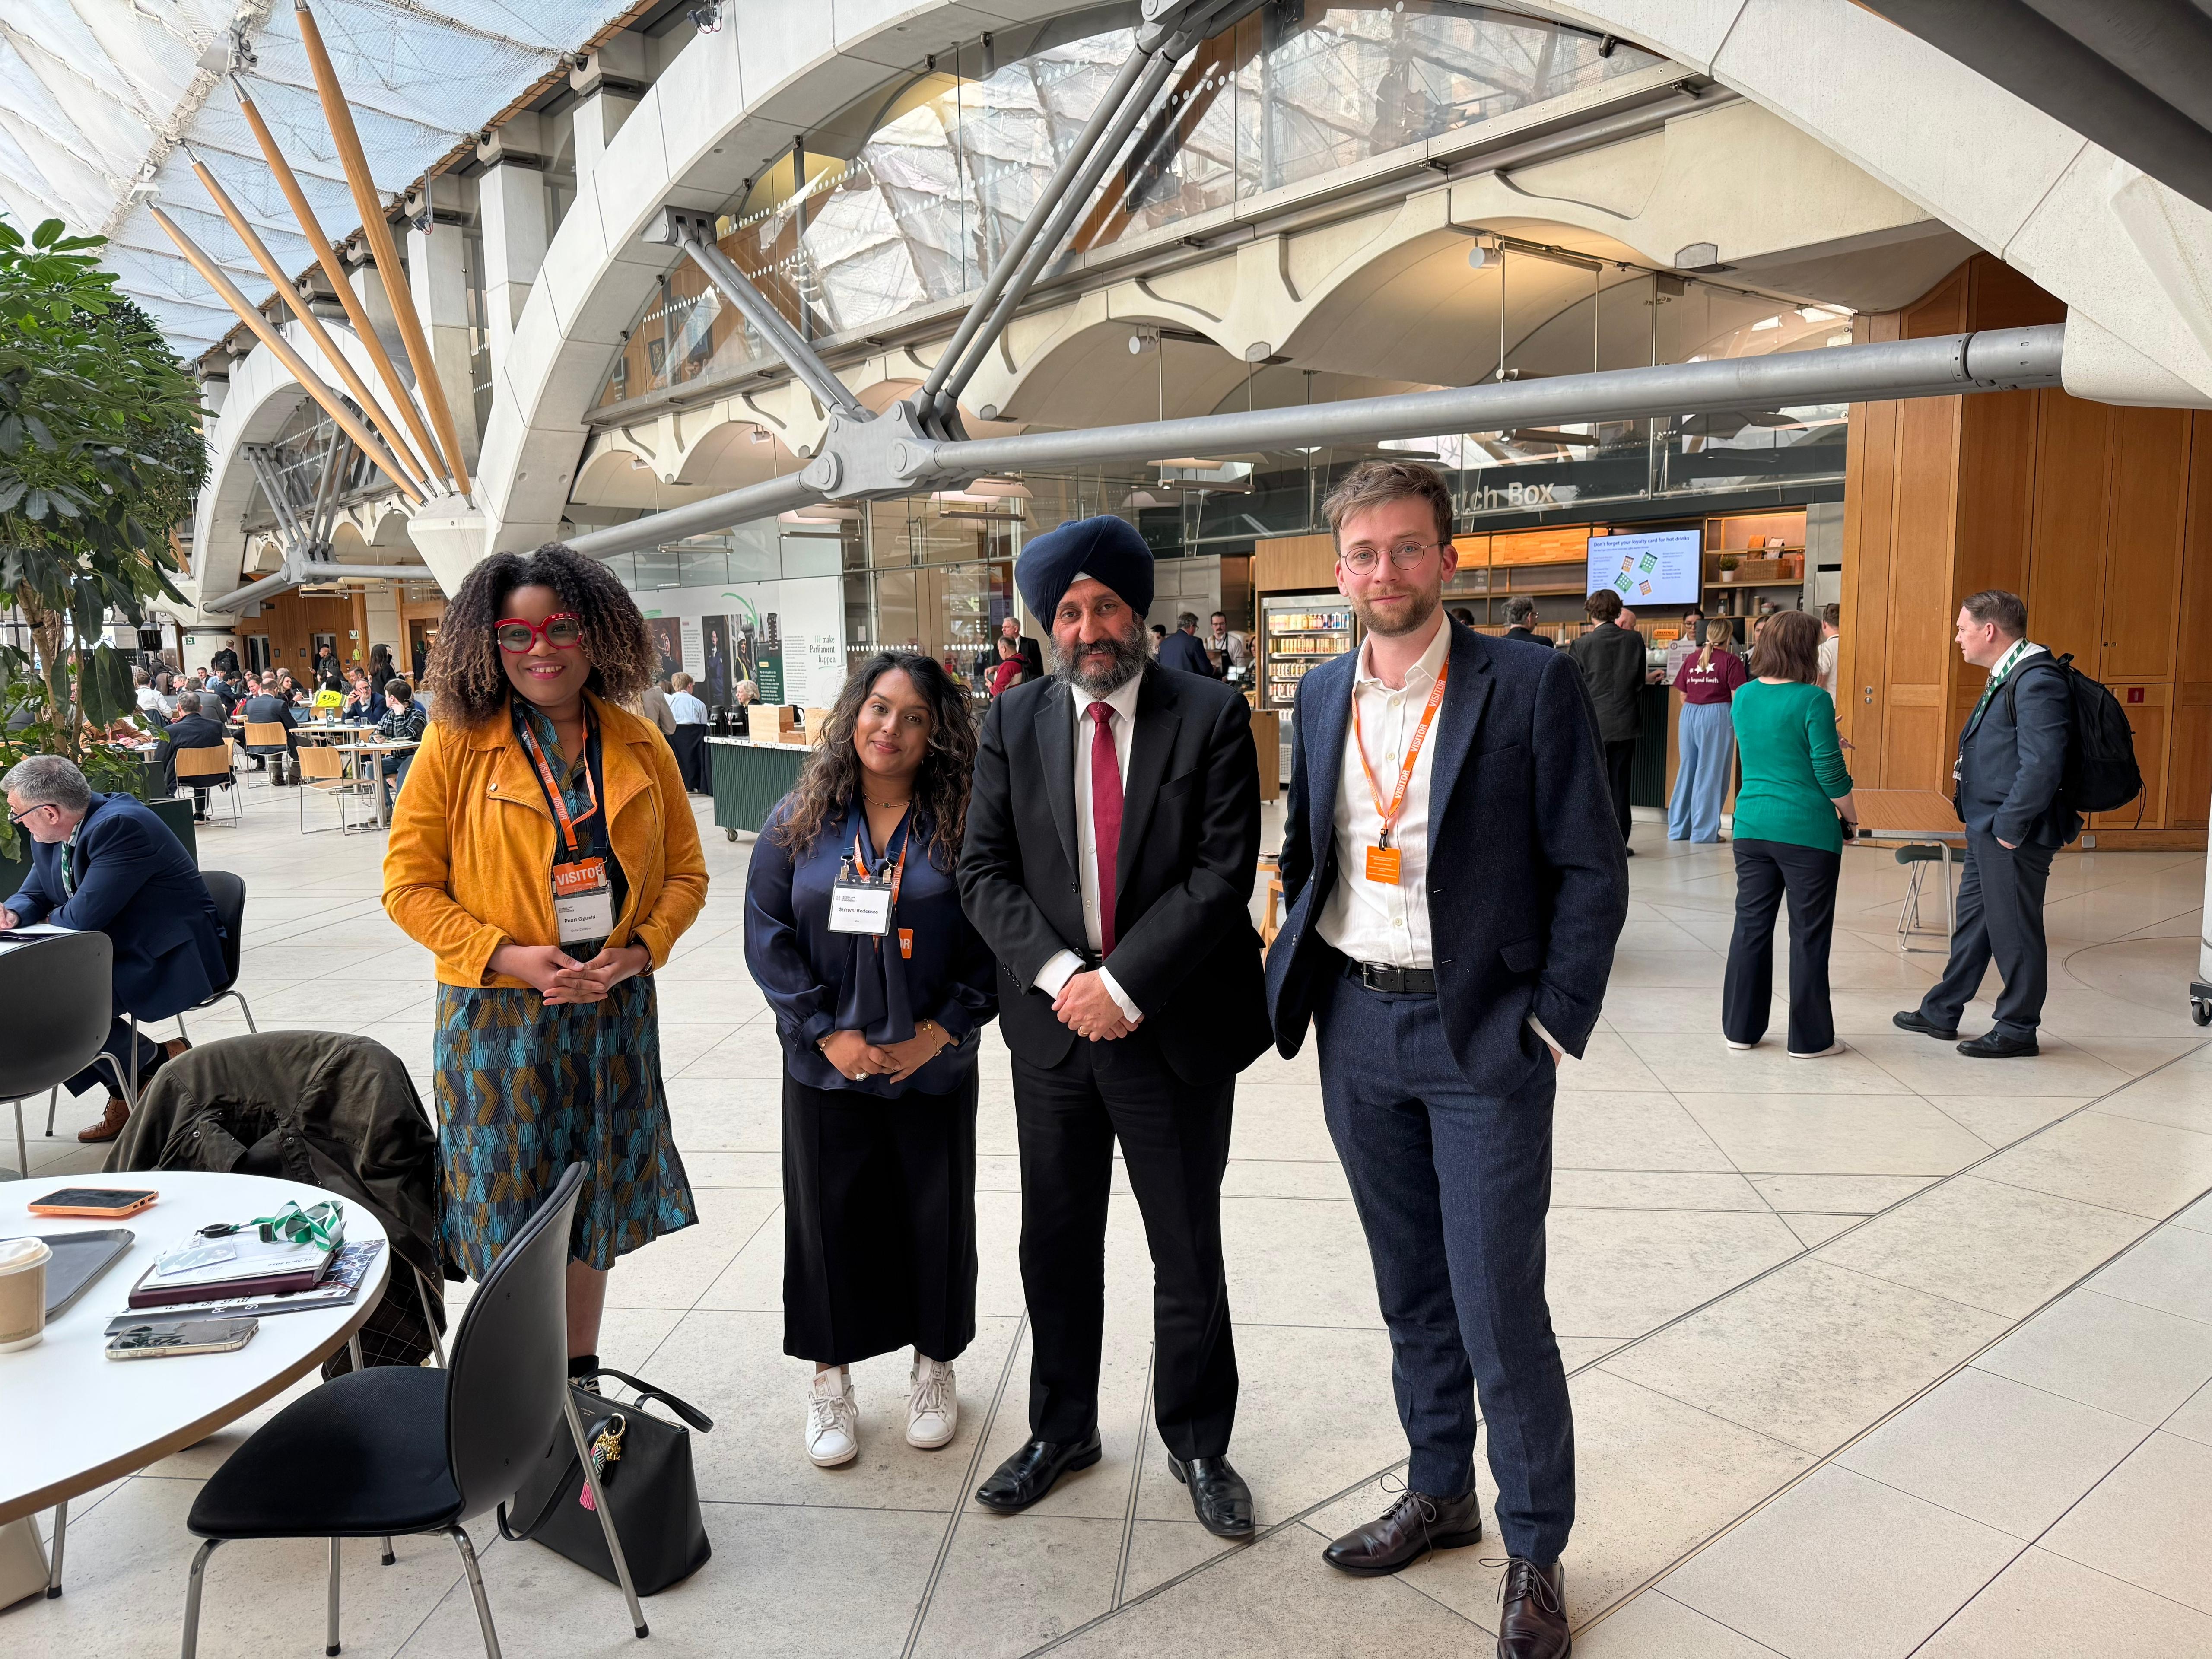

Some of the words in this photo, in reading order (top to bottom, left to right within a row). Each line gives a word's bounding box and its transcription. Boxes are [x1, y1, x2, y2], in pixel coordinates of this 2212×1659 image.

[1508, 482, 1555, 507] Box
[810, 645, 835, 653] Parliament
[822, 635, 835, 643] make
[818, 655, 836, 665] happen
[1691, 677, 1705, 685] beyond
[1428, 679, 1446, 707] VISITOR
[1410, 724, 1427, 752] VISITOR
[539, 762, 553, 784] VISITOR
[1394, 769, 1410, 799] VISITOR
[552, 796, 568, 820] VISITOR
